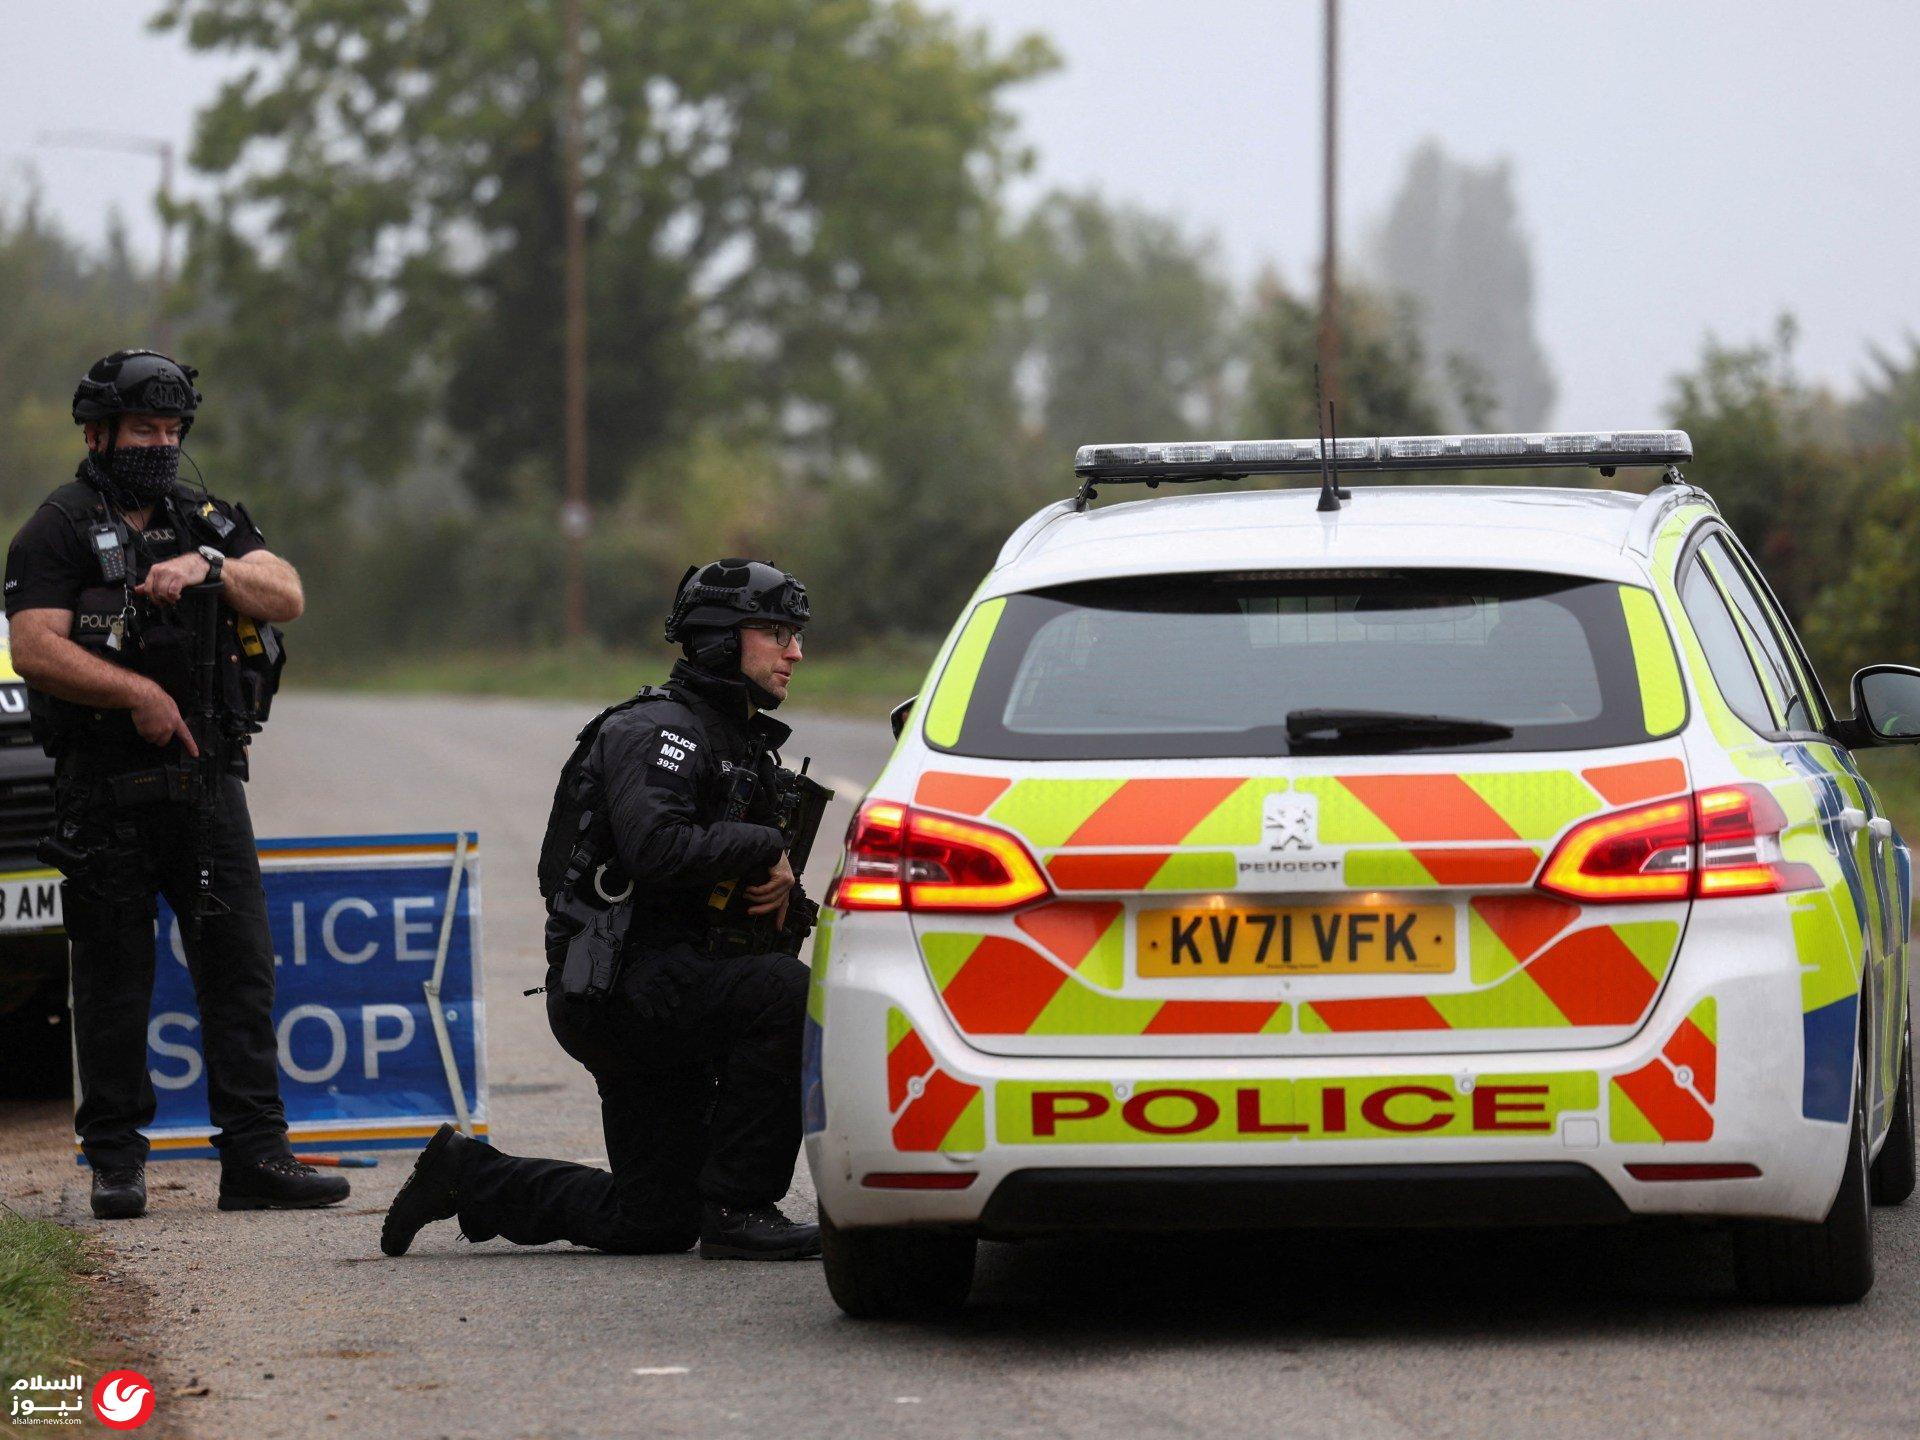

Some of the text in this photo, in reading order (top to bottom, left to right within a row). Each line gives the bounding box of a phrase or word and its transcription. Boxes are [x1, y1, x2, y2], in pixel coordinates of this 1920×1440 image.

[141, 529, 176, 542] POLIC
[80, 615, 124, 628] POLIC
[660, 730, 697, 752] POLICE
[660, 743, 685, 761] MD
[656, 758, 680, 772] 3921
[1239, 861, 1340, 873] PEUGEOT
[17, 884, 61, 920] AM
[1171, 913, 1418, 964] KV71 VFK
[147, 1004, 416, 1090] SOP
[1031, 1085, 1551, 1136] POLICE
